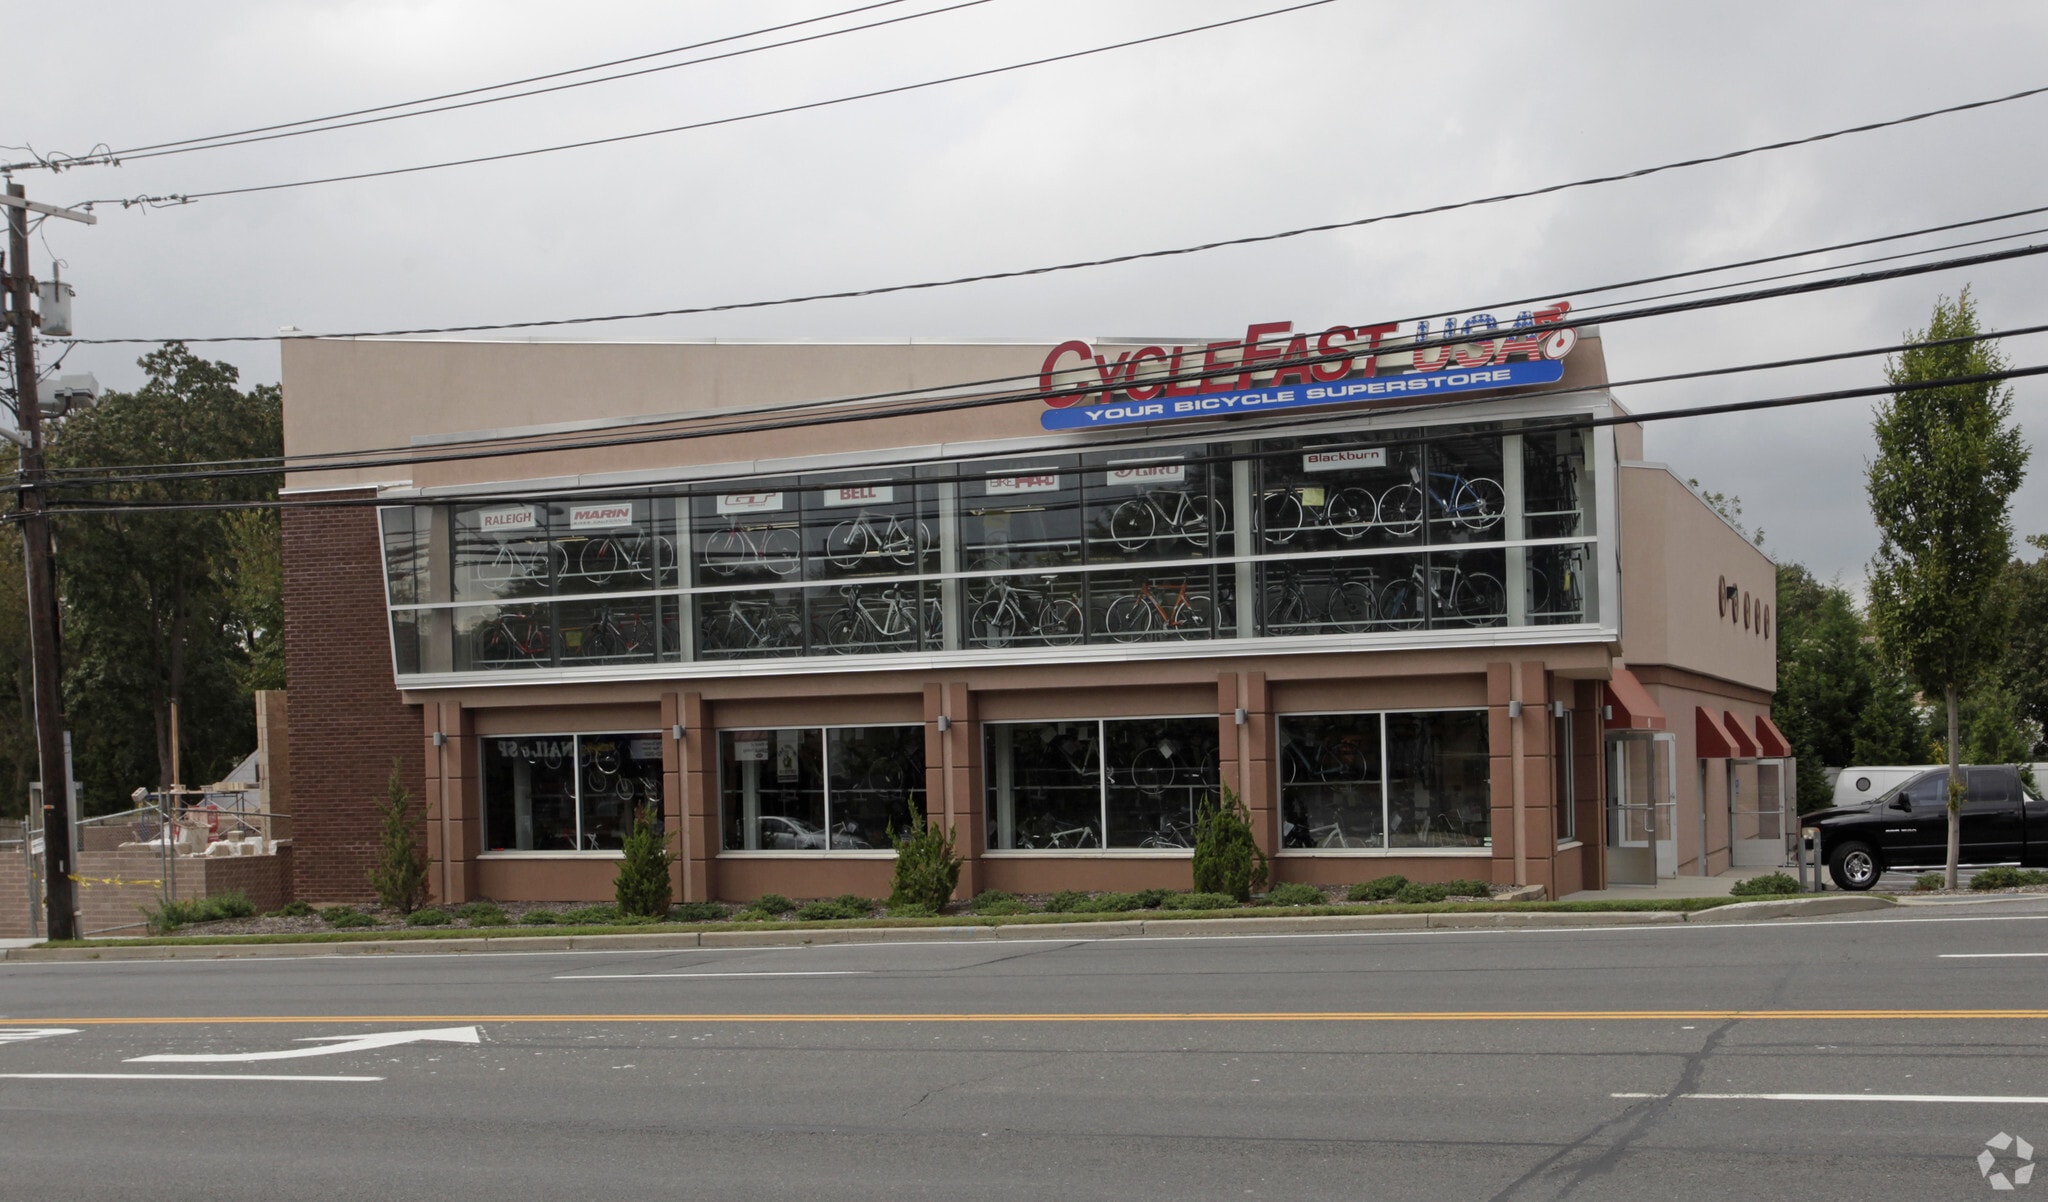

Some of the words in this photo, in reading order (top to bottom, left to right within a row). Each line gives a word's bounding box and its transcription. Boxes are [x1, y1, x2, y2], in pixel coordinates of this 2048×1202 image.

[1413, 310, 1542, 373] USA
[1085, 404, 1164, 421] YOUR
[1174, 390, 1295, 413] BICYCLE
[1306, 369, 1511, 400] SUPERSTORE
[1308, 451, 1379, 463] Blackburn
[1135, 465, 1180, 477] GIRO
[725, 492, 776, 506] GT
[839, 487, 877, 501] BELL
[484, 512, 532, 527] RALEIGH
[574, 508, 630, 521] MARIN
